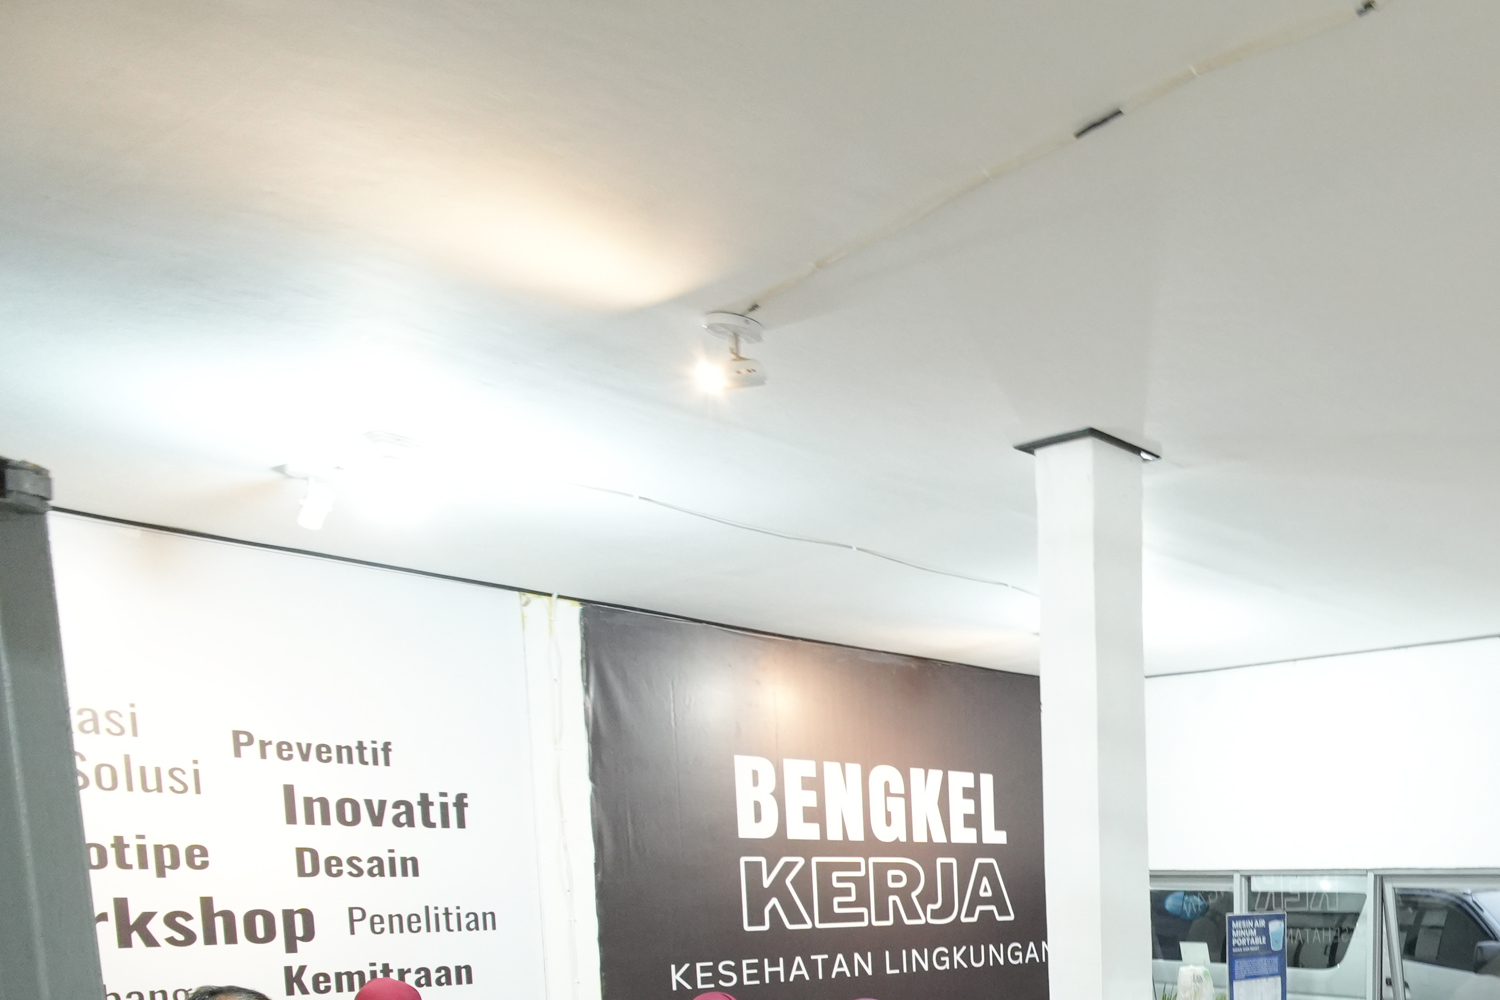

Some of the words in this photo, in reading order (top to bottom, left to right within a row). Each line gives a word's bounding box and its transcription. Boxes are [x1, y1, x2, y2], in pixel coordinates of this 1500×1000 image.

[76, 703, 138, 738] asi
[231, 729, 392, 767] Preventif
[282, 783, 469, 829] Inovatif
[733, 754, 1007, 845] BENGKEL
[86, 834, 210, 878] otipe
[295, 846, 420, 878] Desain
[739, 856, 1015, 931] KERJA
[348, 905, 497, 936] Penelitian
[1231, 928, 1257, 938] MINUM
[1254, 919, 1266, 928] AIR
[1232, 935, 1267, 947] PORTABLE
[670, 951, 874, 991] KESEHATAN
